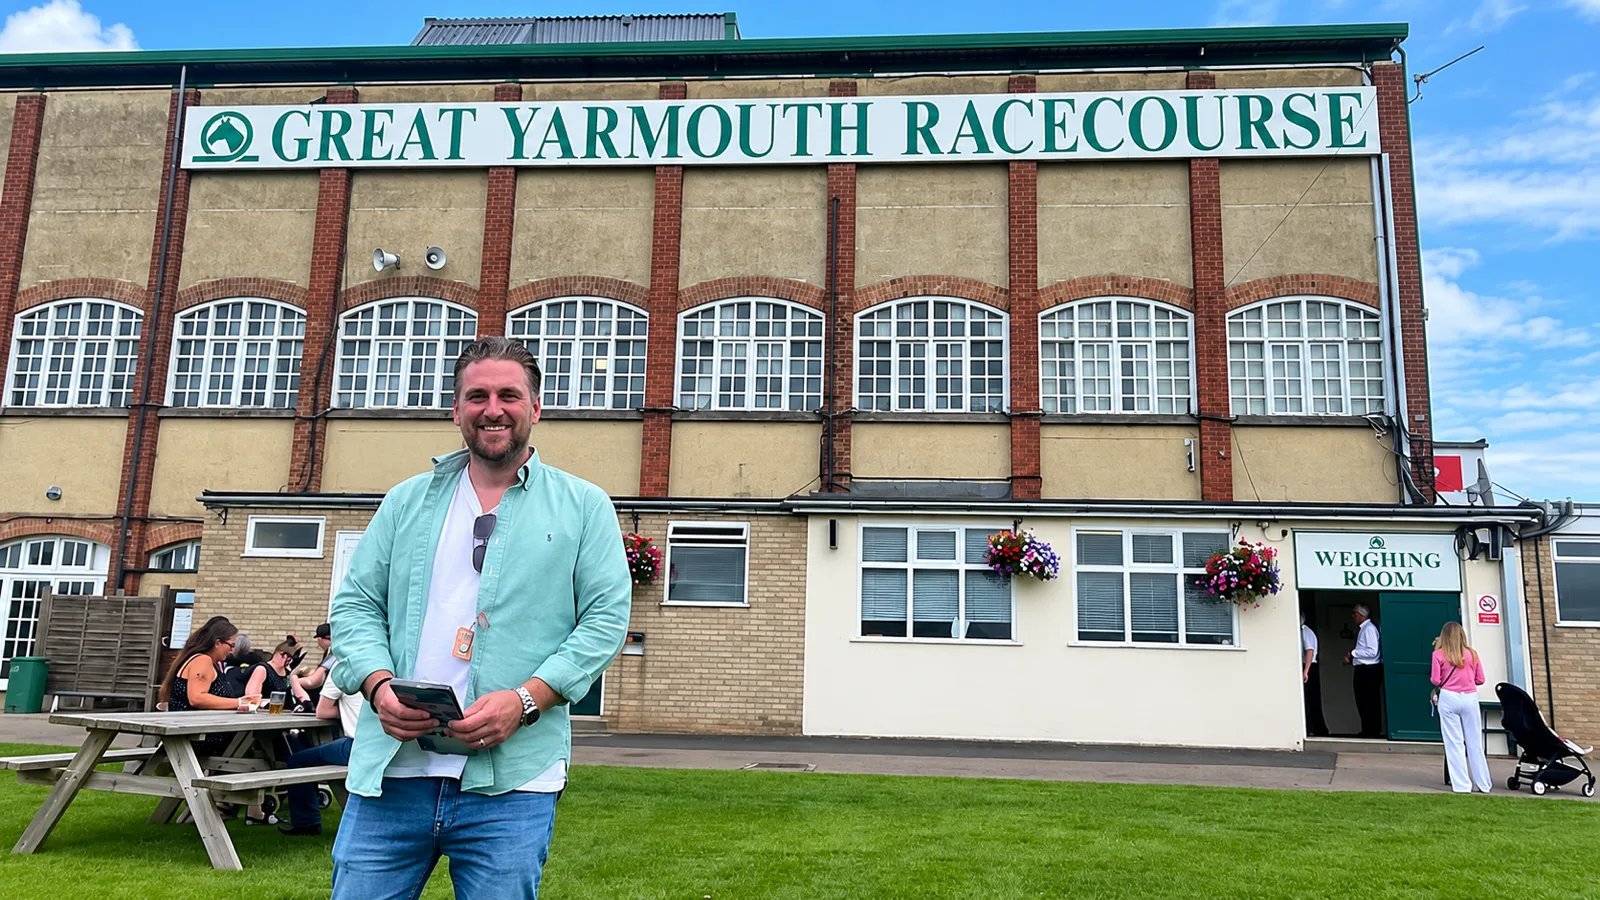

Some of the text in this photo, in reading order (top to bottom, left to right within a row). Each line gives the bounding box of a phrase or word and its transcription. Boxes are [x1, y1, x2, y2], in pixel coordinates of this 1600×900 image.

[272, 92, 1367, 162] GREAT YARMOUTH RACECOURSE
[1315, 550, 1441, 569] WEIGHING
[1343, 570, 1414, 587] ROOM
